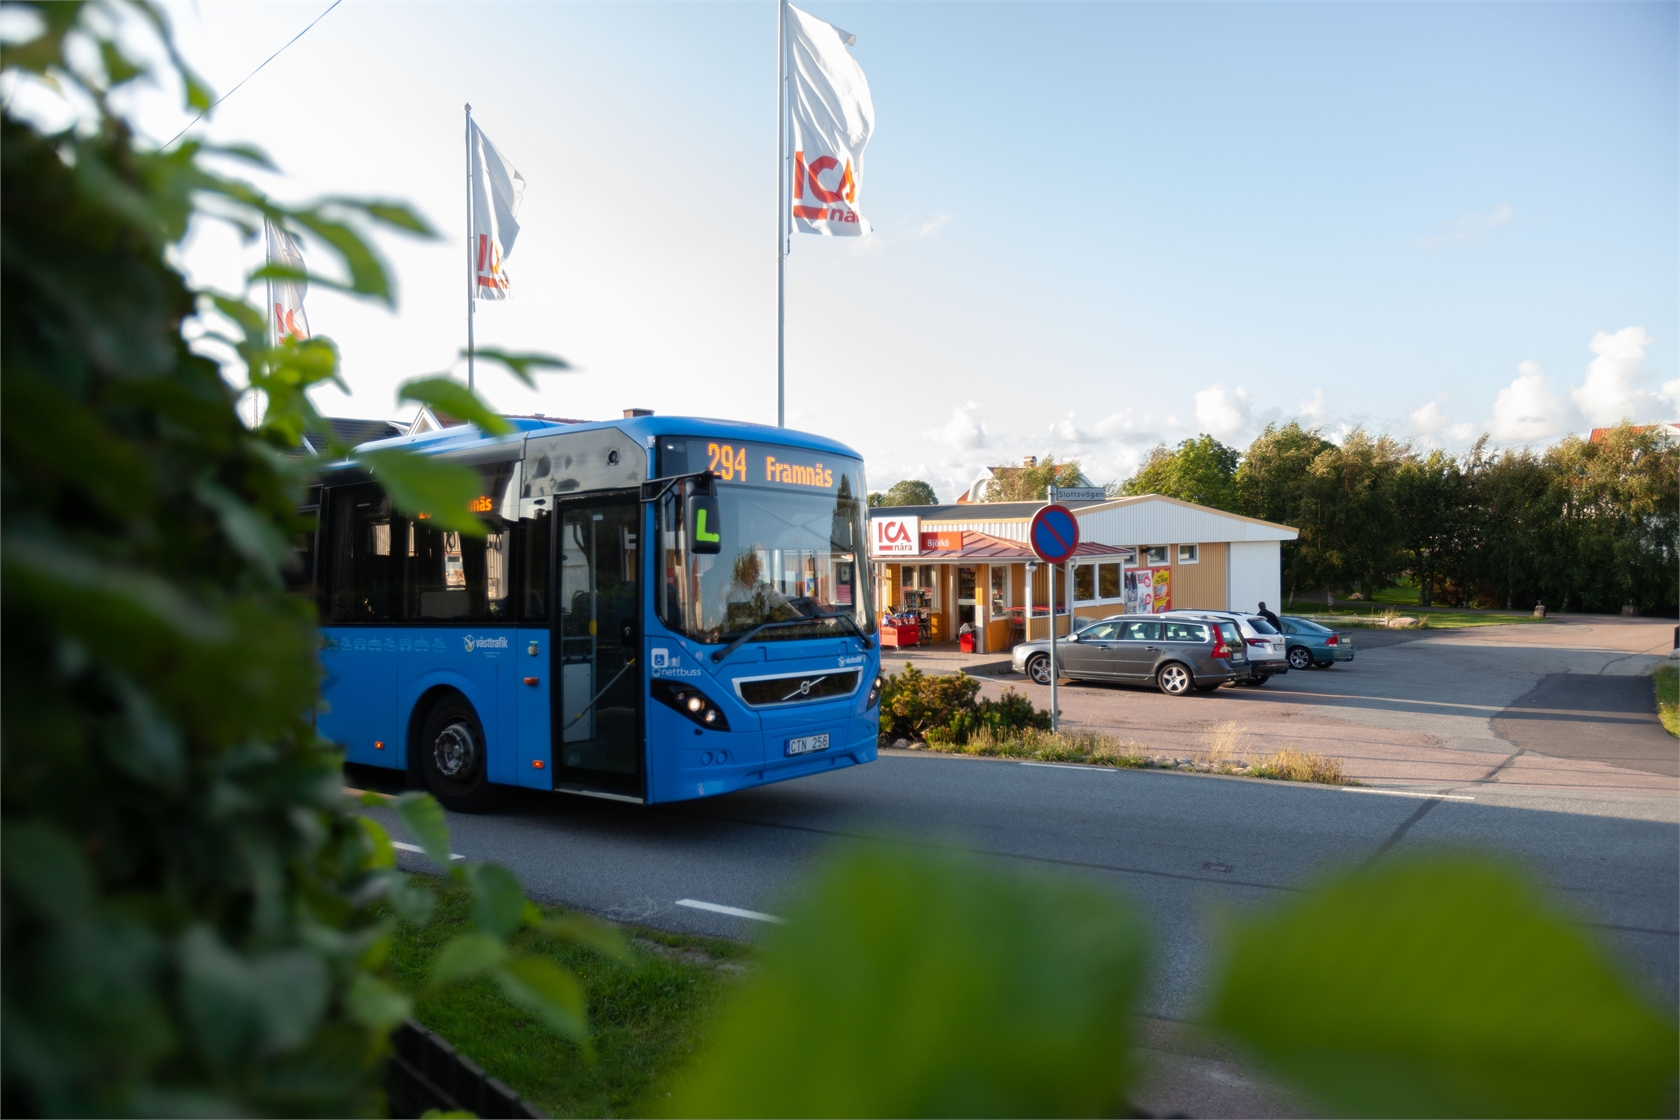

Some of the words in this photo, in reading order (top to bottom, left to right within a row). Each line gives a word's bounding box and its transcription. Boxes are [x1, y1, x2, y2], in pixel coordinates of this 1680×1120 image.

[794, 151, 856, 204] ICA
[707, 443, 747, 482] 294
[765, 456, 833, 488] Framnäs
[1058, 490, 1105, 499] Slottsvägen
[878, 521, 912, 543] ICA
[894, 543, 913, 551] nära
[927, 539, 950, 548] Björkö
[475, 636, 508, 649] västtrafik
[661, 668, 702, 677] nettbuss
[790, 739, 807, 753] CTN
[812, 735, 828, 749] 256
